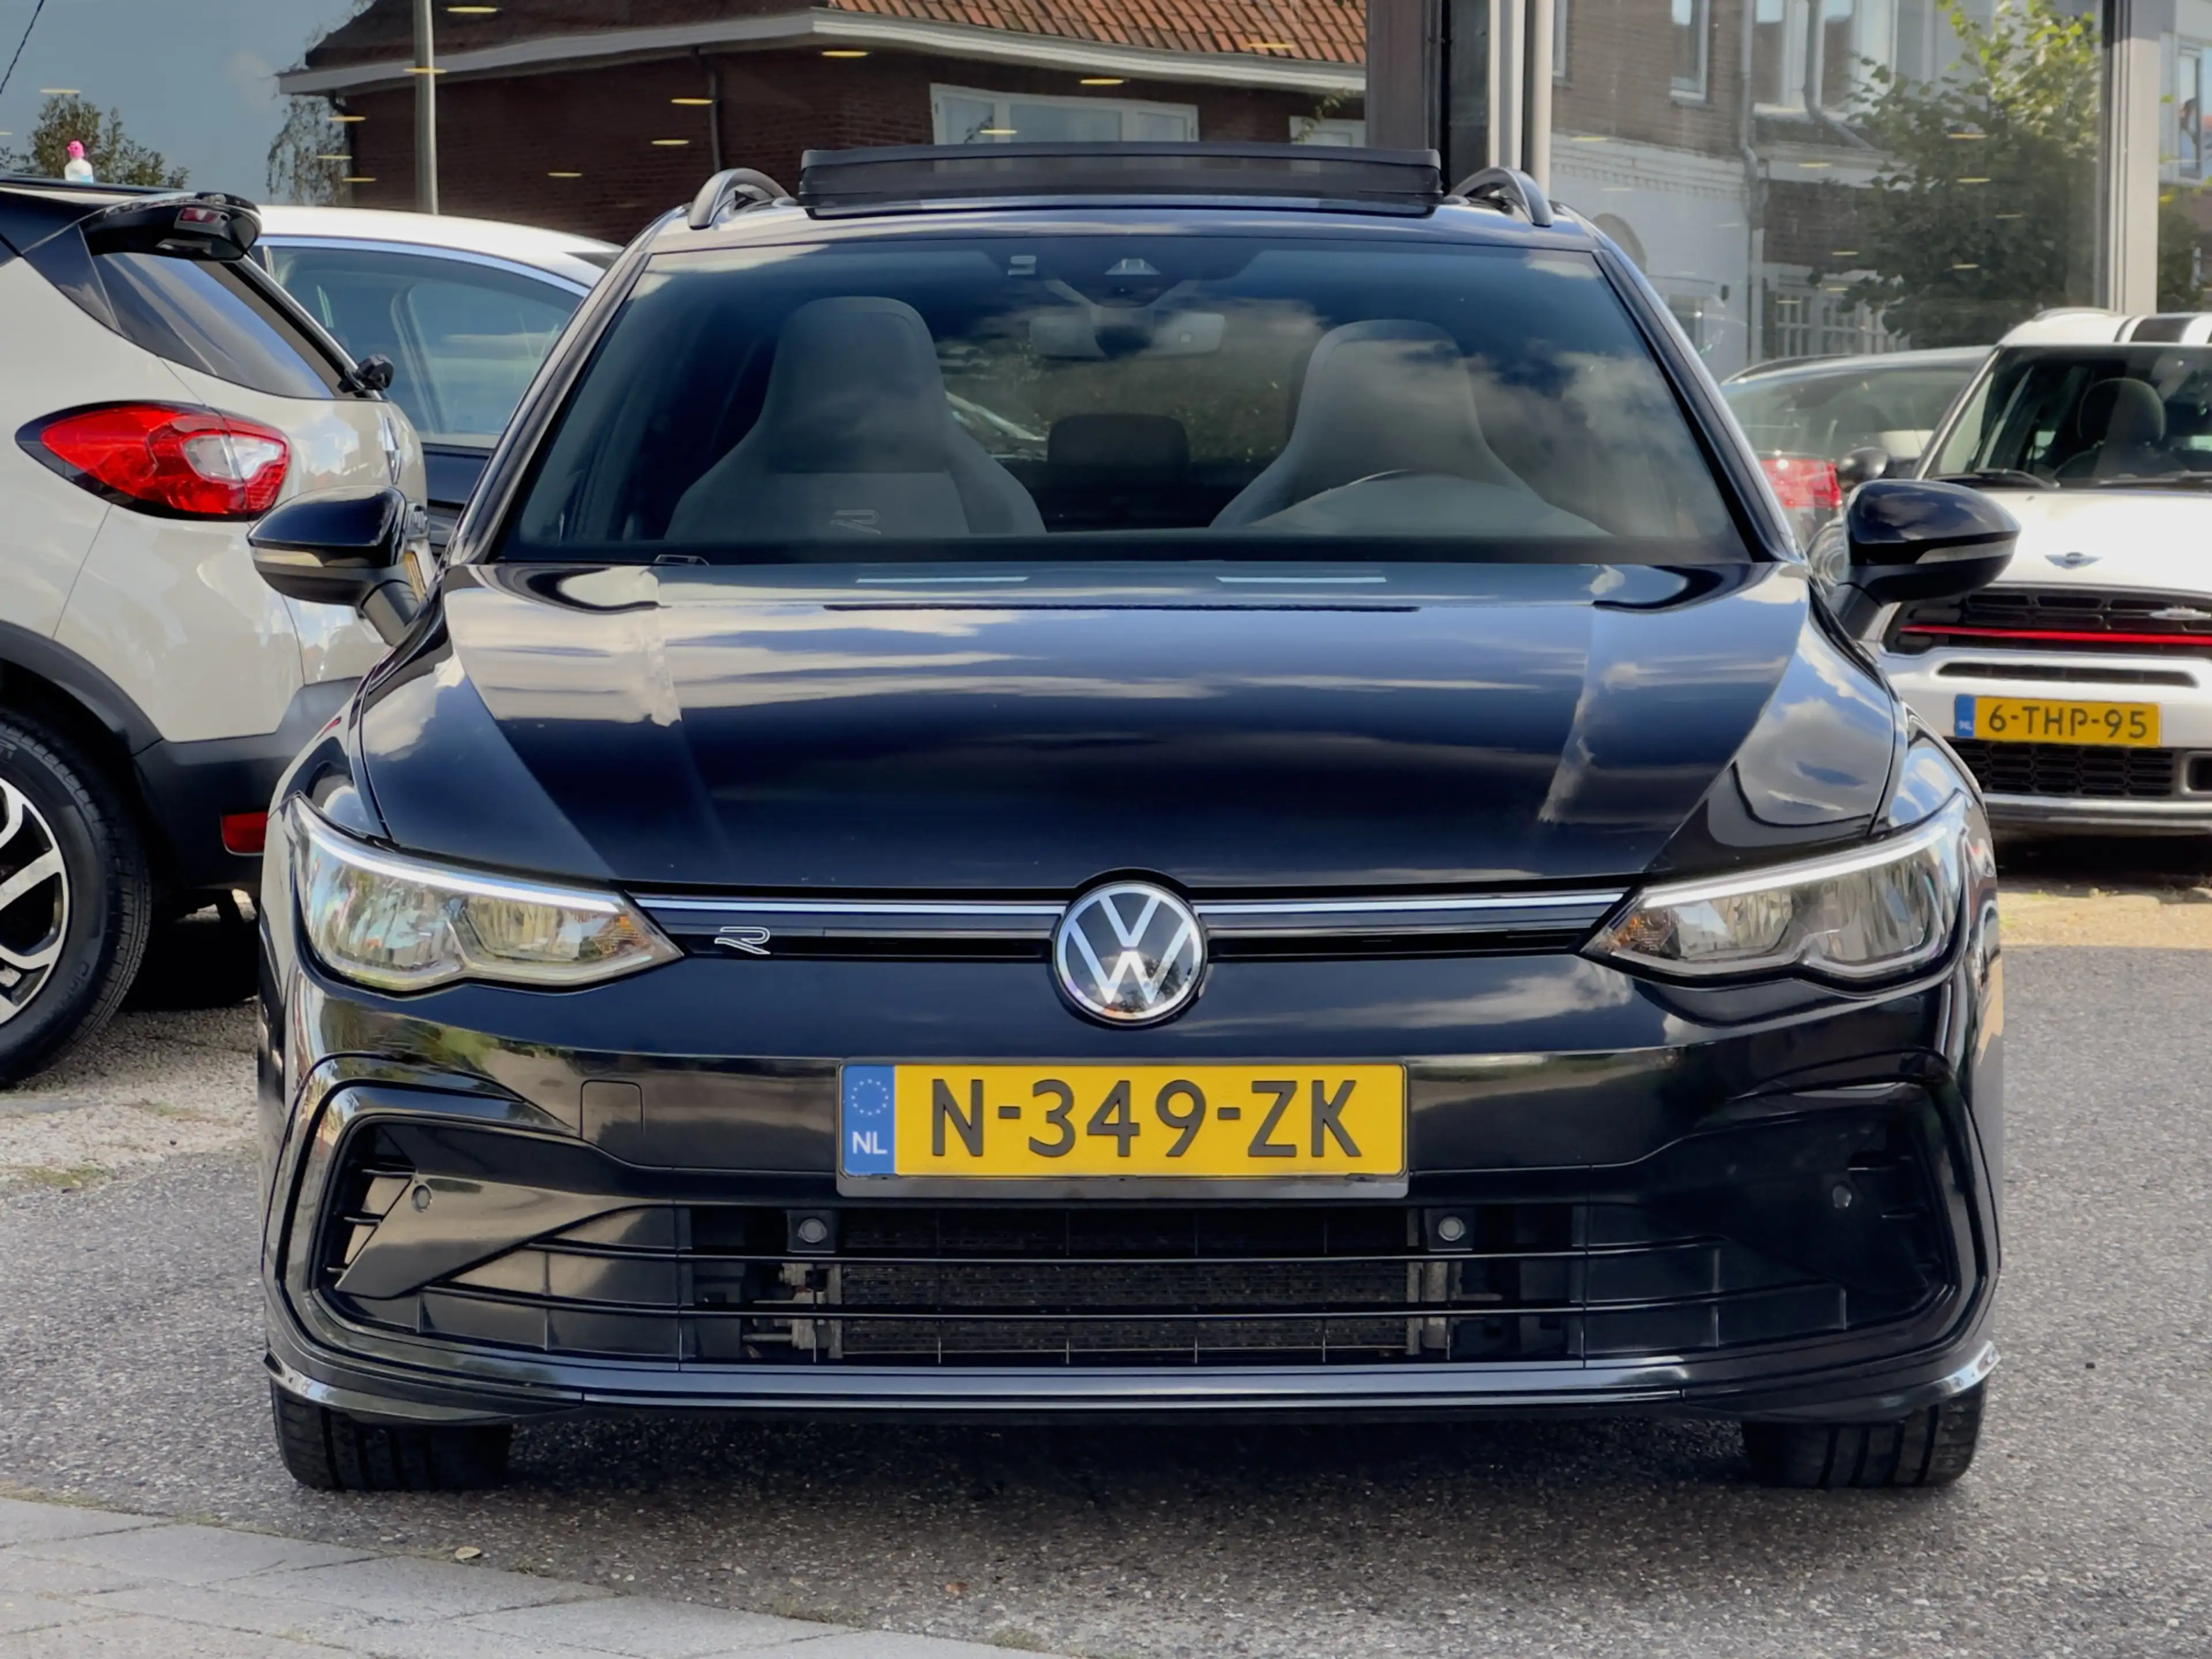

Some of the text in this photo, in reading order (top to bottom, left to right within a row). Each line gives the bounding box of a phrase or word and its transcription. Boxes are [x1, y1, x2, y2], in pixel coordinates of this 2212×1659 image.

[1988, 704, 2147, 740] 6-THP-95
[932, 1078, 1362, 1158] N-349-ZK
[852, 1131, 888, 1154] NL
